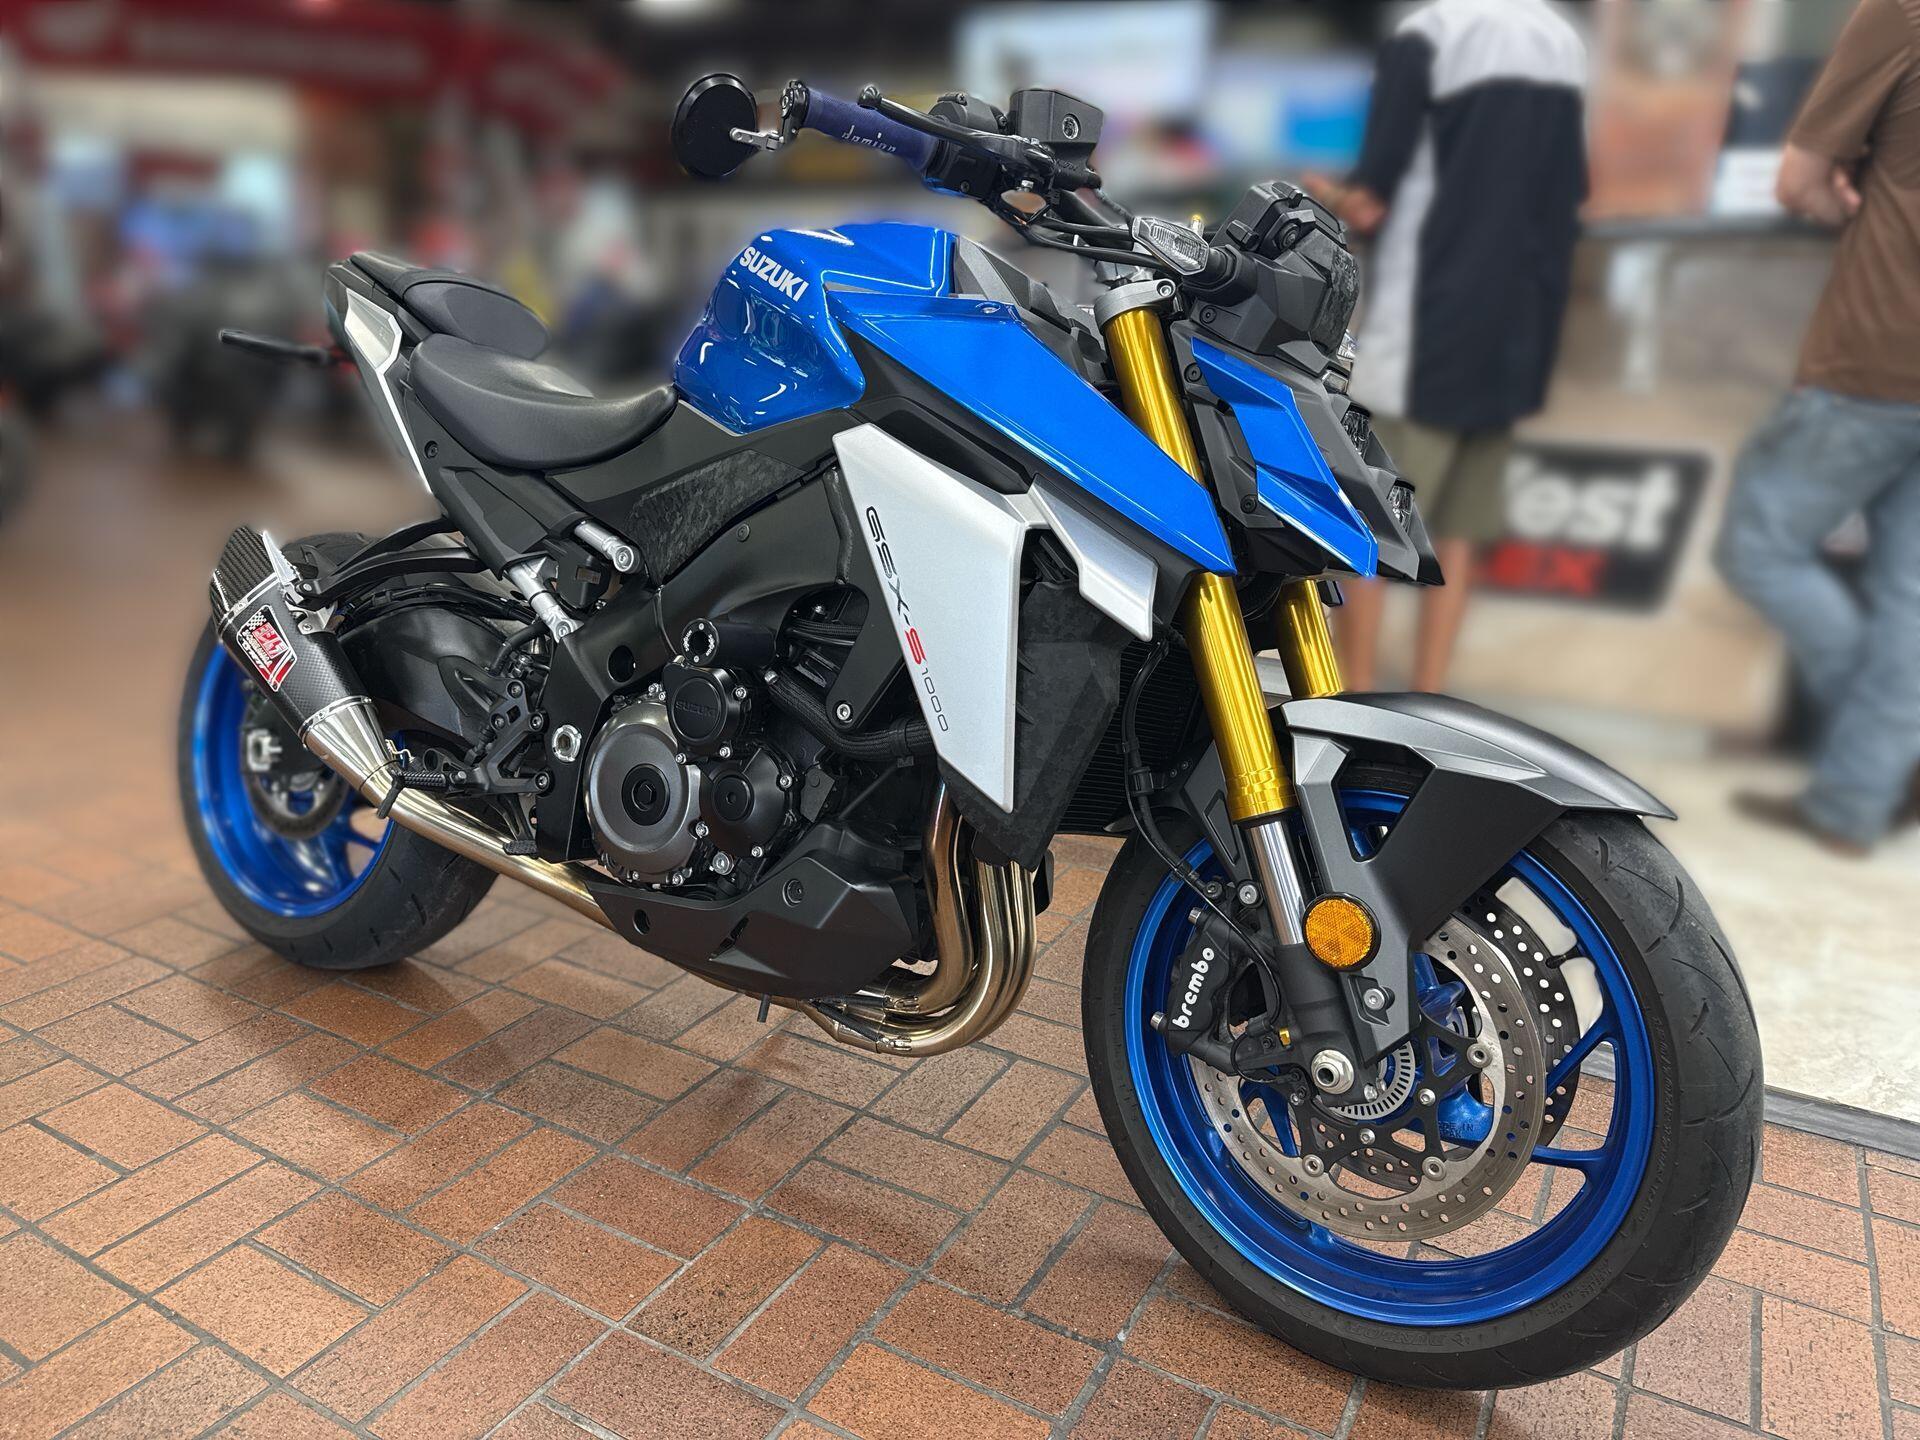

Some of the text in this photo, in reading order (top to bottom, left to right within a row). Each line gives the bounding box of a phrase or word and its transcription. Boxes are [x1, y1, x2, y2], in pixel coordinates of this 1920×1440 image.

[841, 124, 896, 153] domino
[739, 246, 809, 302] SUZUKI
[675, 699, 720, 718] SUZUKI
[1171, 947, 1215, 1029] brembo
